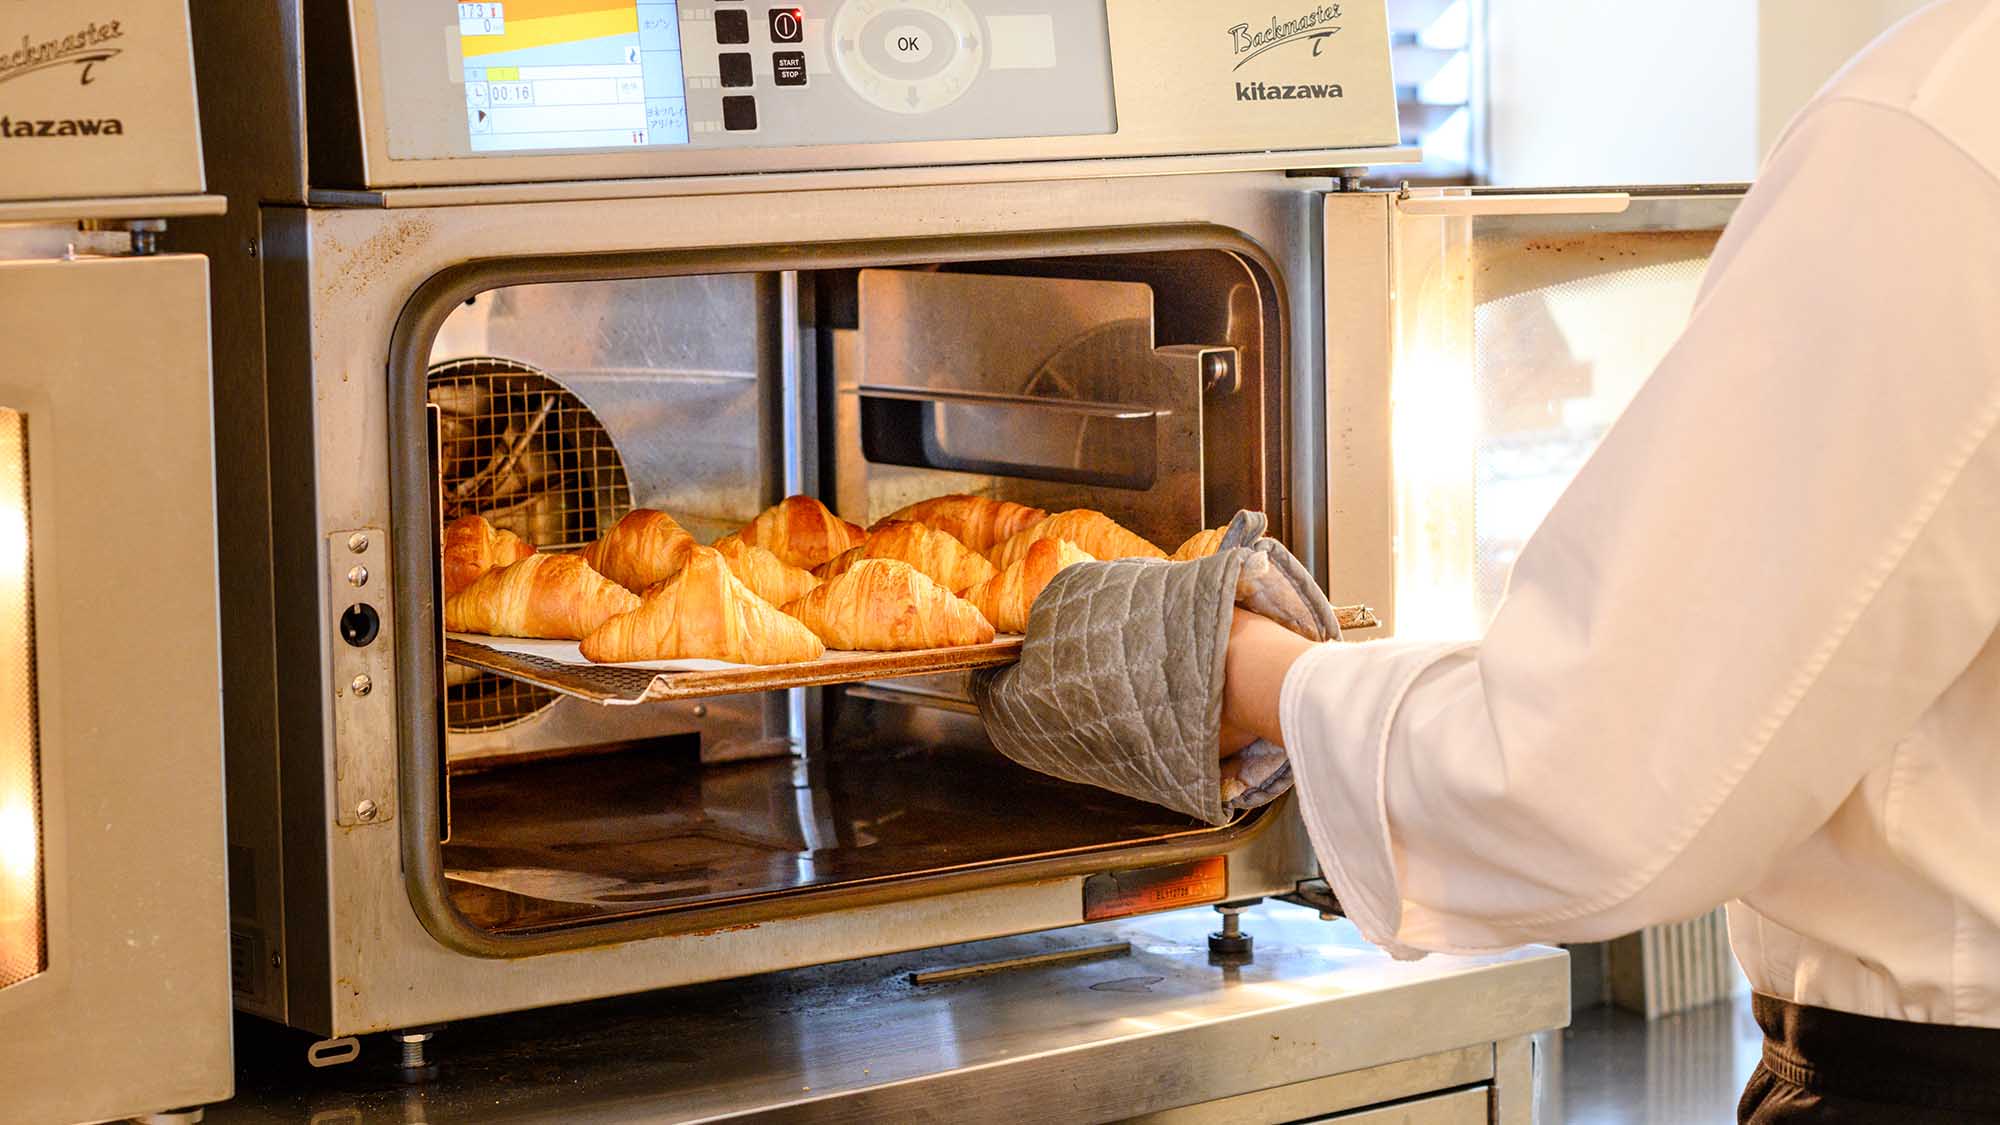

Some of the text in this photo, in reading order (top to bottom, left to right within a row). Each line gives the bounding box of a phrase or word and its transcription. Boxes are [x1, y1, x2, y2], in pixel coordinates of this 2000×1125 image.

[461, 4, 483, 17] 173
[1228, 3, 1342, 54] Backmaster
[897, 36, 919, 51] OK
[1235, 82, 1343, 101] kitazawa
